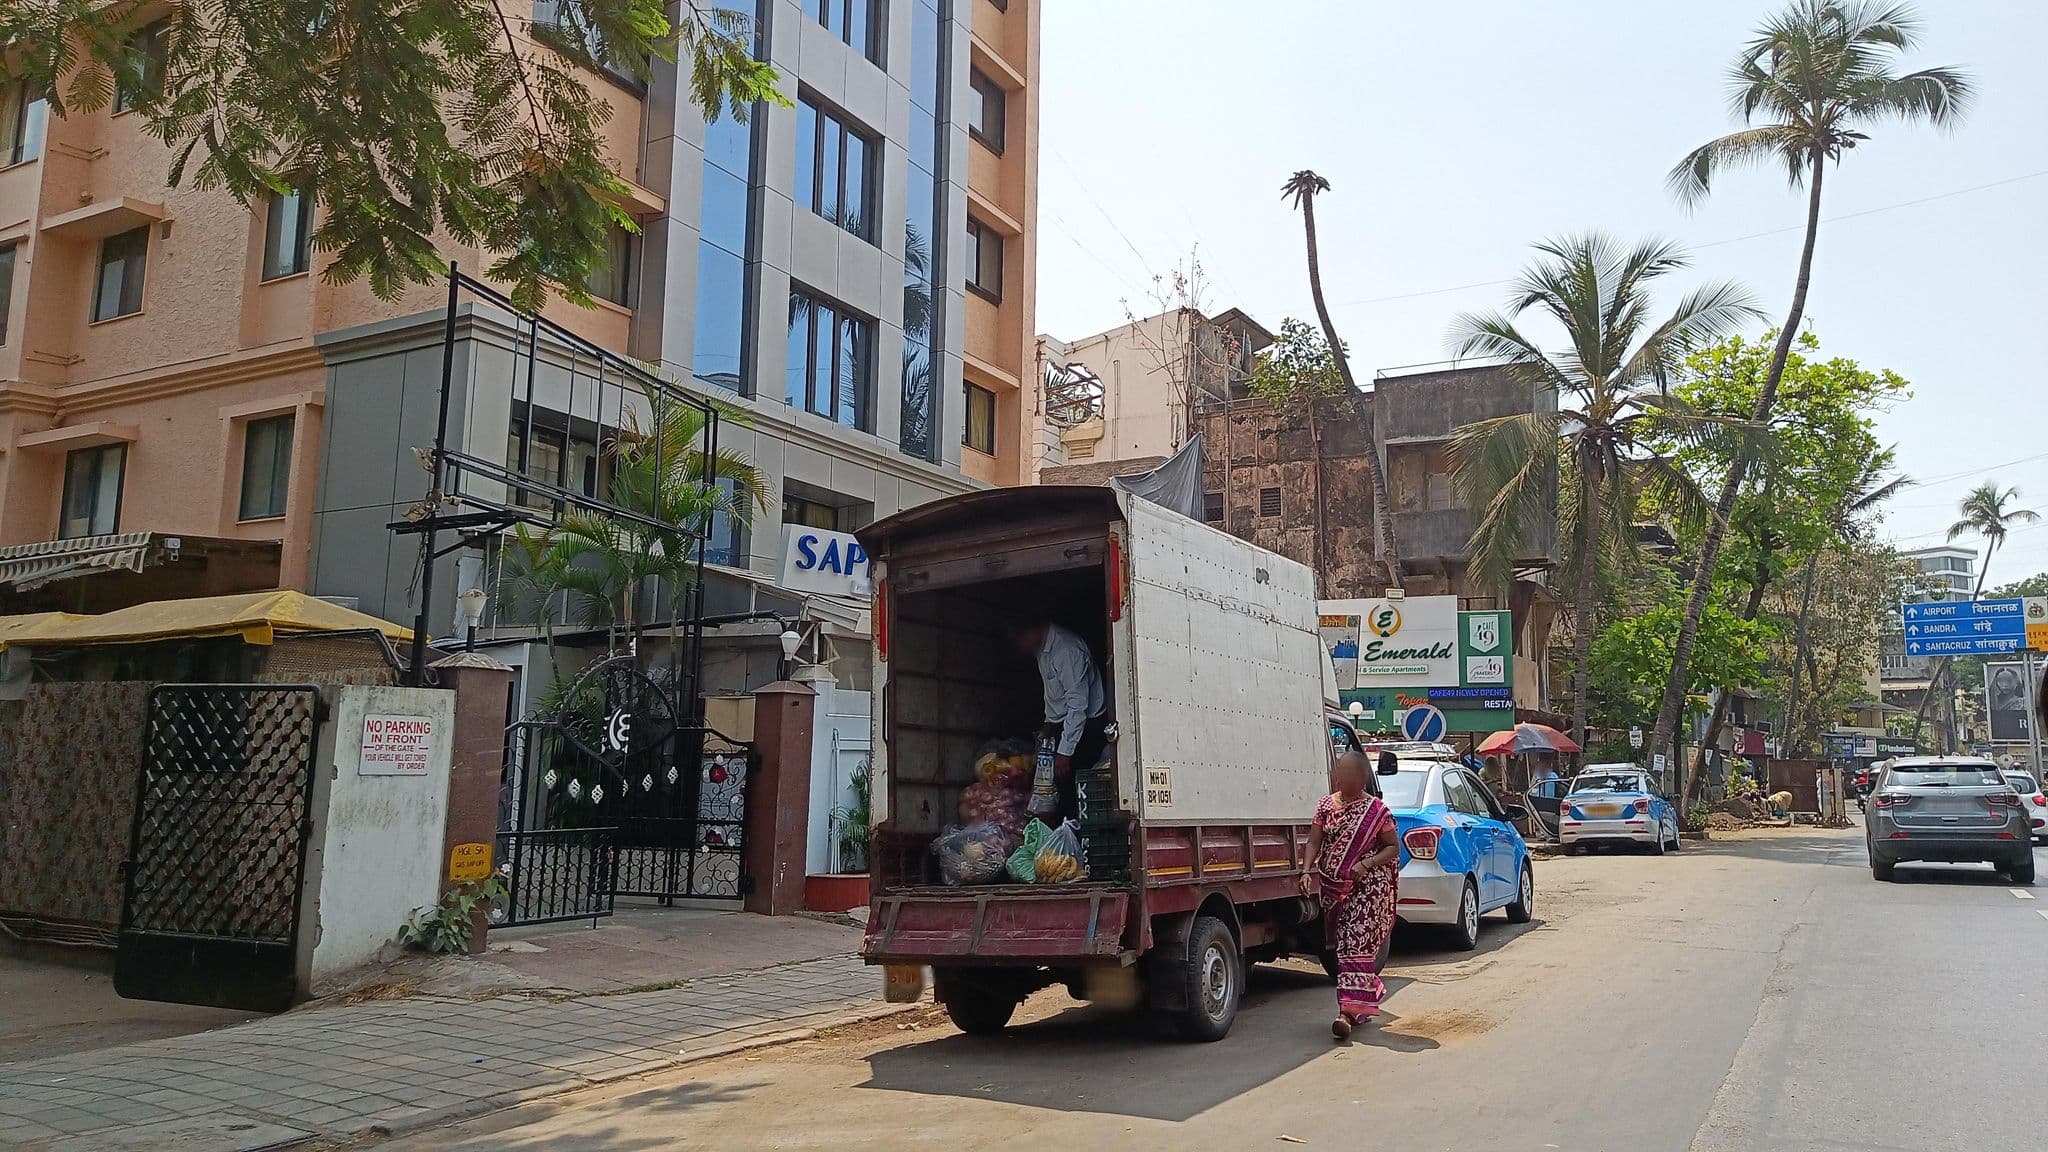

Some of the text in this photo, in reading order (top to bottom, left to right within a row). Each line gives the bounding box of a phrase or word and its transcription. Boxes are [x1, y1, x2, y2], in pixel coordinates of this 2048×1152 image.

[796, 535, 870, 578] SAP
[1923, 606, 1956, 616] AIRPORT
[1924, 625, 1957, 633] BANDRA
[1364, 640, 1453, 662] Emerald
[1925, 642, 1971, 651] SANTACRUZ
[1391, 666, 1426, 674] Apartments
[1480, 688, 1509, 696] OPENED
[366, 720, 431, 734] NO PARKING
[2019, 719, 2027, 729] R
[371, 734, 423, 744] IN FRONT
